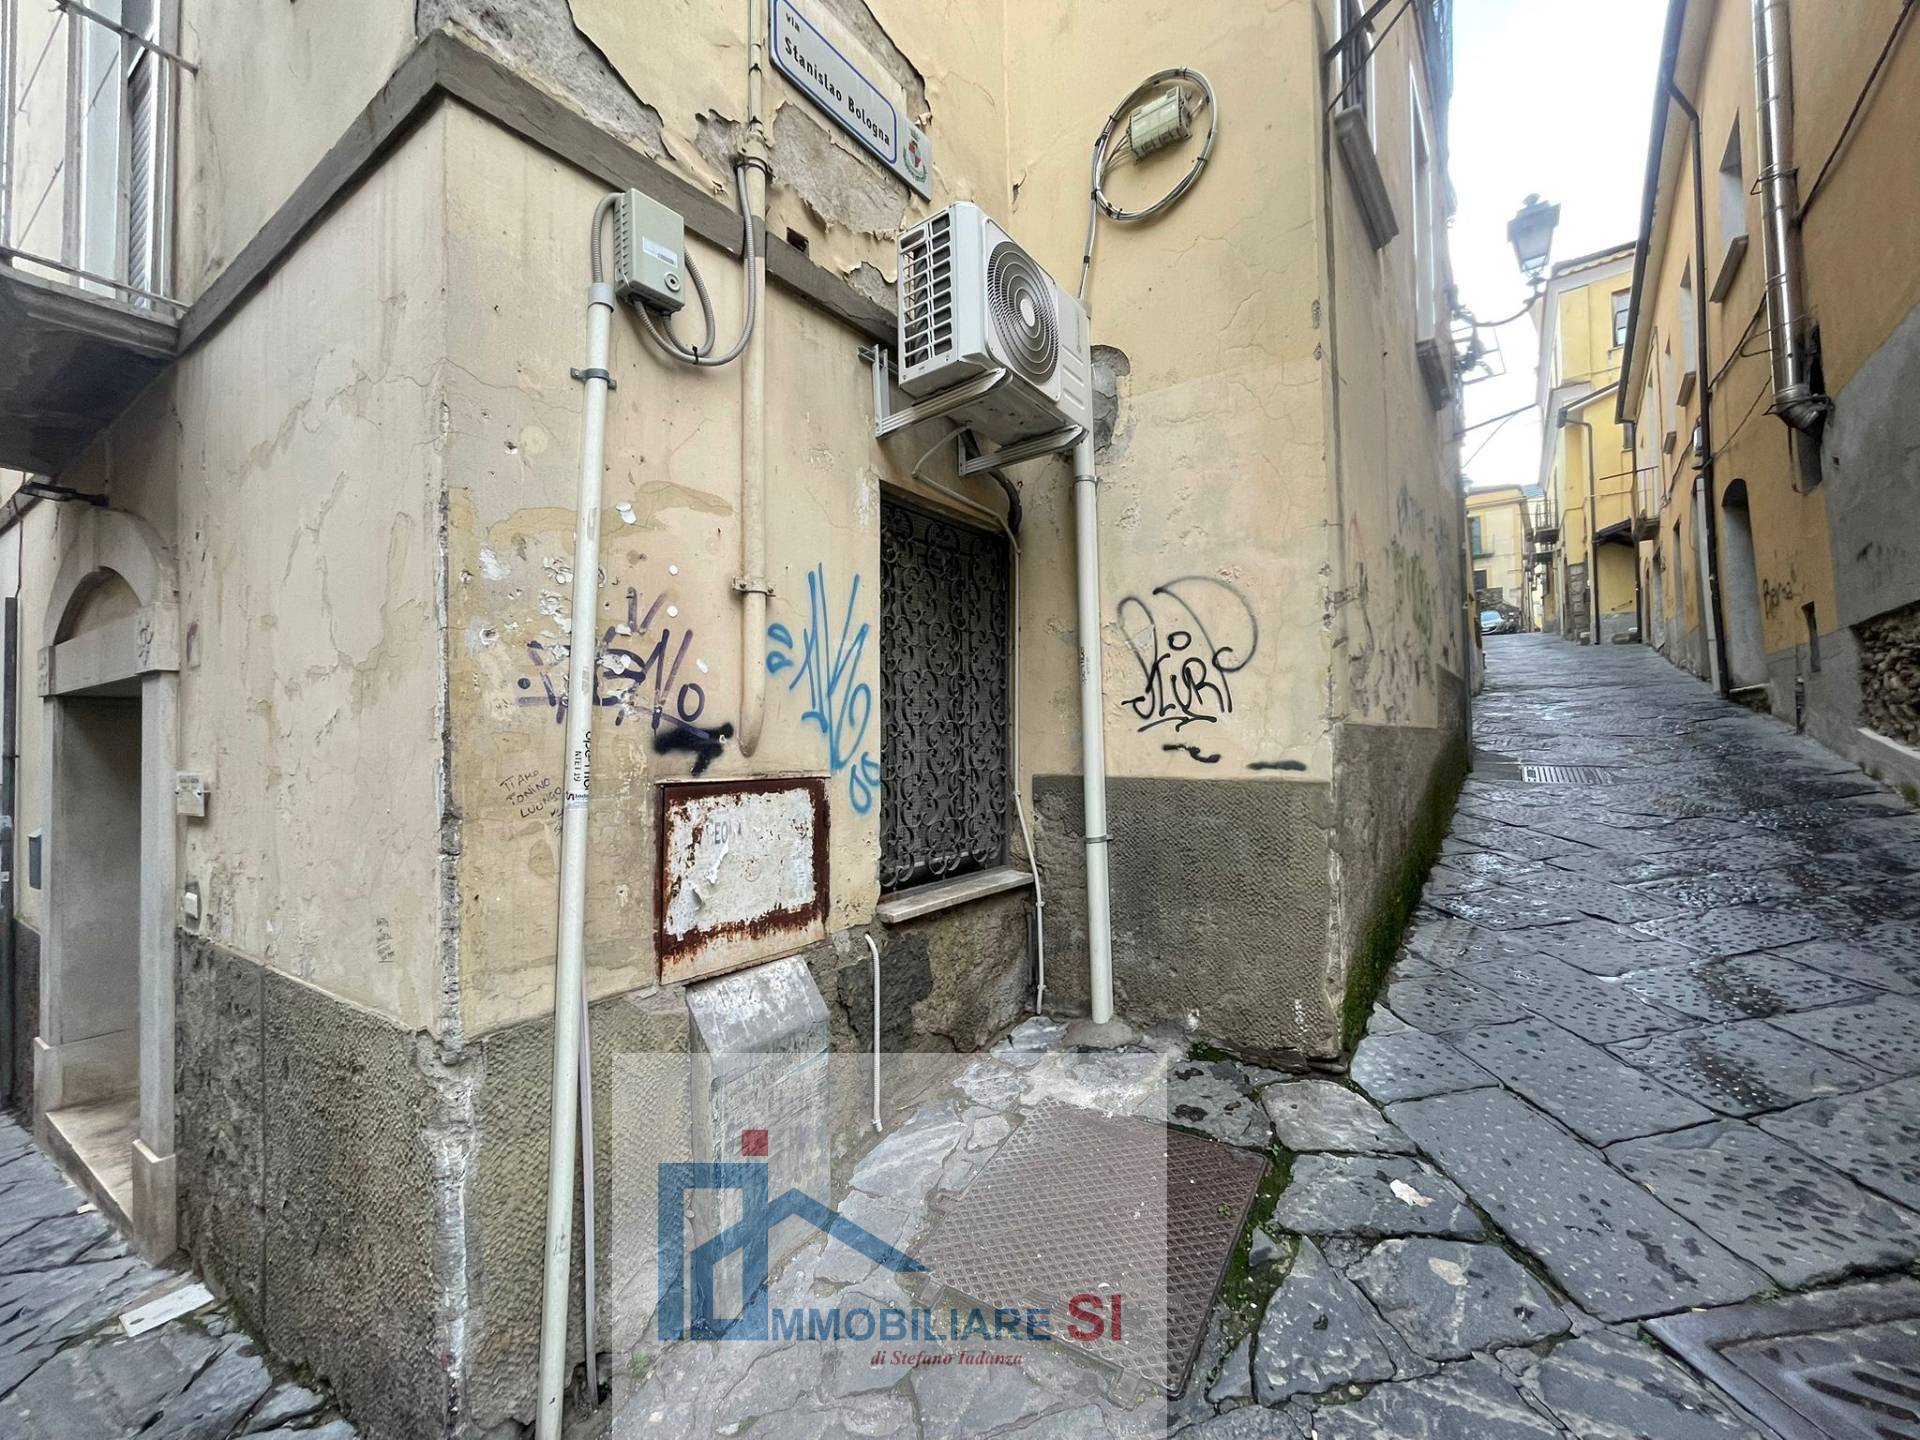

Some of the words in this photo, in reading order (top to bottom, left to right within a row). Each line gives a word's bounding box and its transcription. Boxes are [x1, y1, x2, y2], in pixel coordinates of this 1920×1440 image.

[785, 13, 800, 33] via
[784, 36, 842, 101] Stanislao
[848, 96, 890, 146] Bologna
